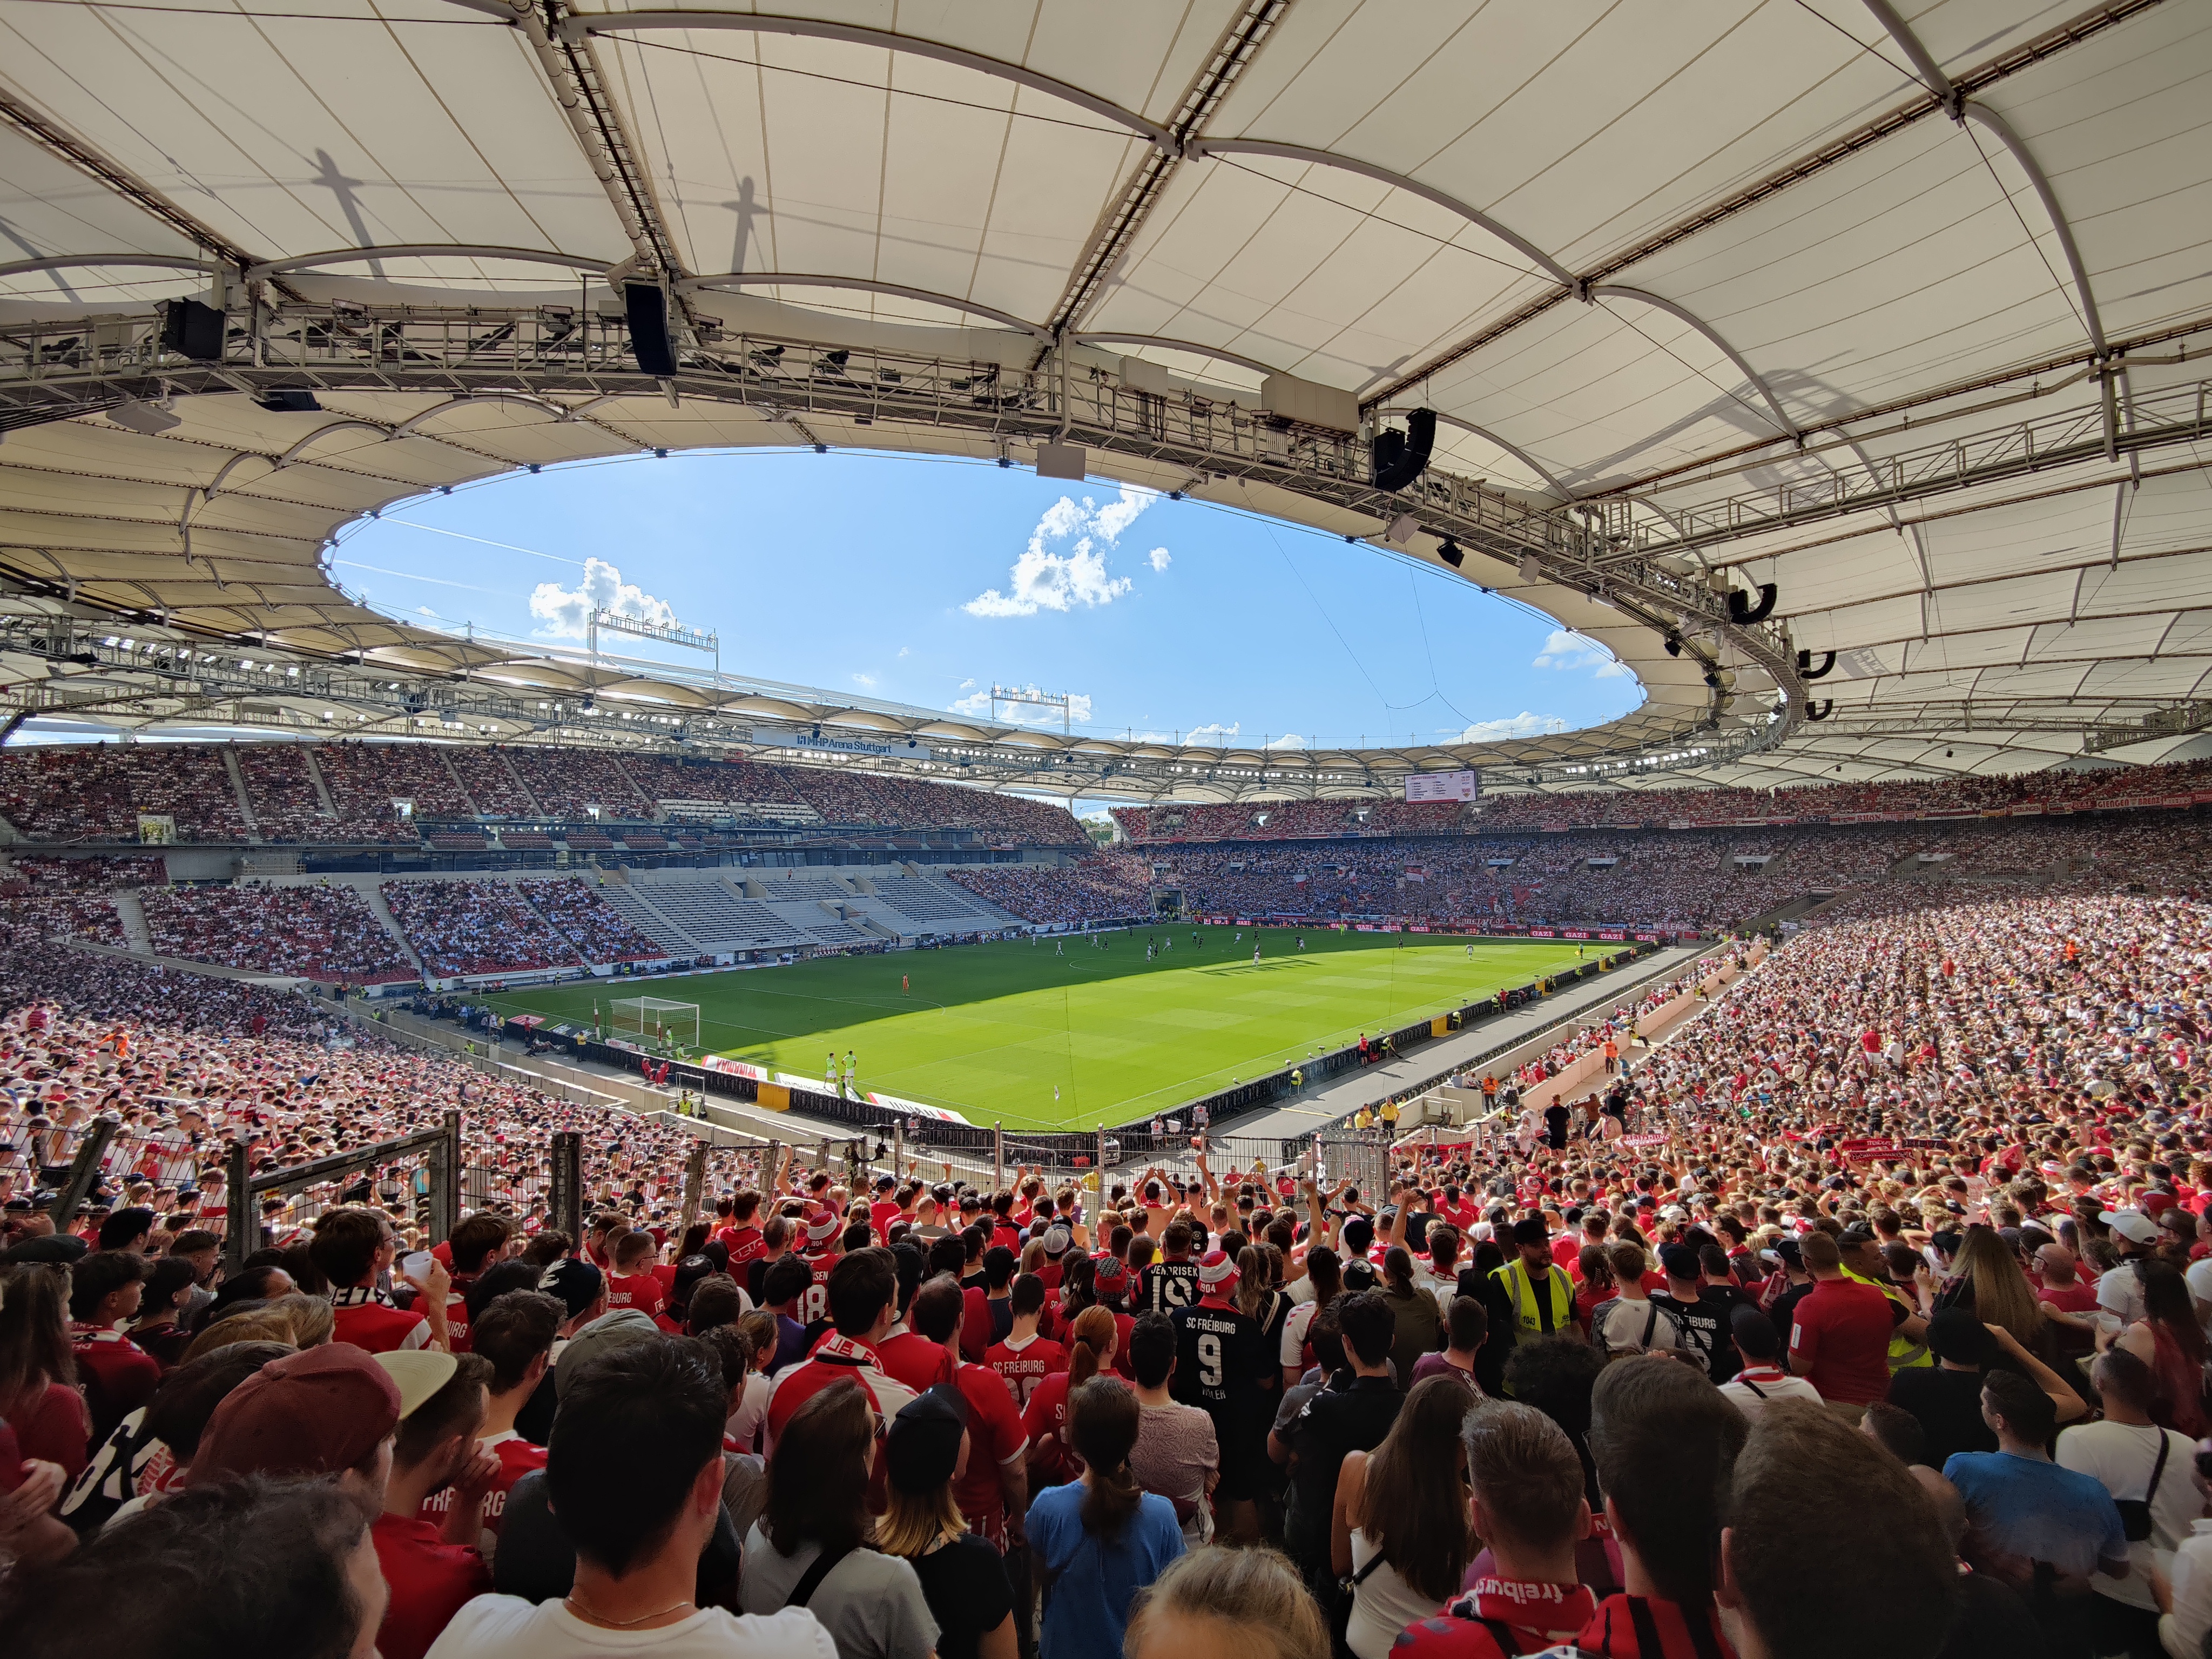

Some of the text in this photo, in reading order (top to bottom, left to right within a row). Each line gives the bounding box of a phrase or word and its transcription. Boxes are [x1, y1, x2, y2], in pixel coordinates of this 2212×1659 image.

[807, 736, 892, 754] MHP Arena Stuttgart
[2098, 799, 2129, 808] GIENGEN
[2138, 797, 2161, 805] BRENZ
[1479, 825, 1541, 834] NECKARSTADION
[716, 1058, 758, 1078] WINAMAX
[1200, 1282, 1216, 1293] 1904
[797, 1284, 826, 1326] 18
[1152, 1276, 1192, 1317] 19
[1186, 1317, 1236, 1334] SC FREIBURG
[1523, 1316, 1536, 1326] 1043
[993, 1360, 1045, 1374] SC FREIBURG
[1198, 1333, 1222, 1386] 9
